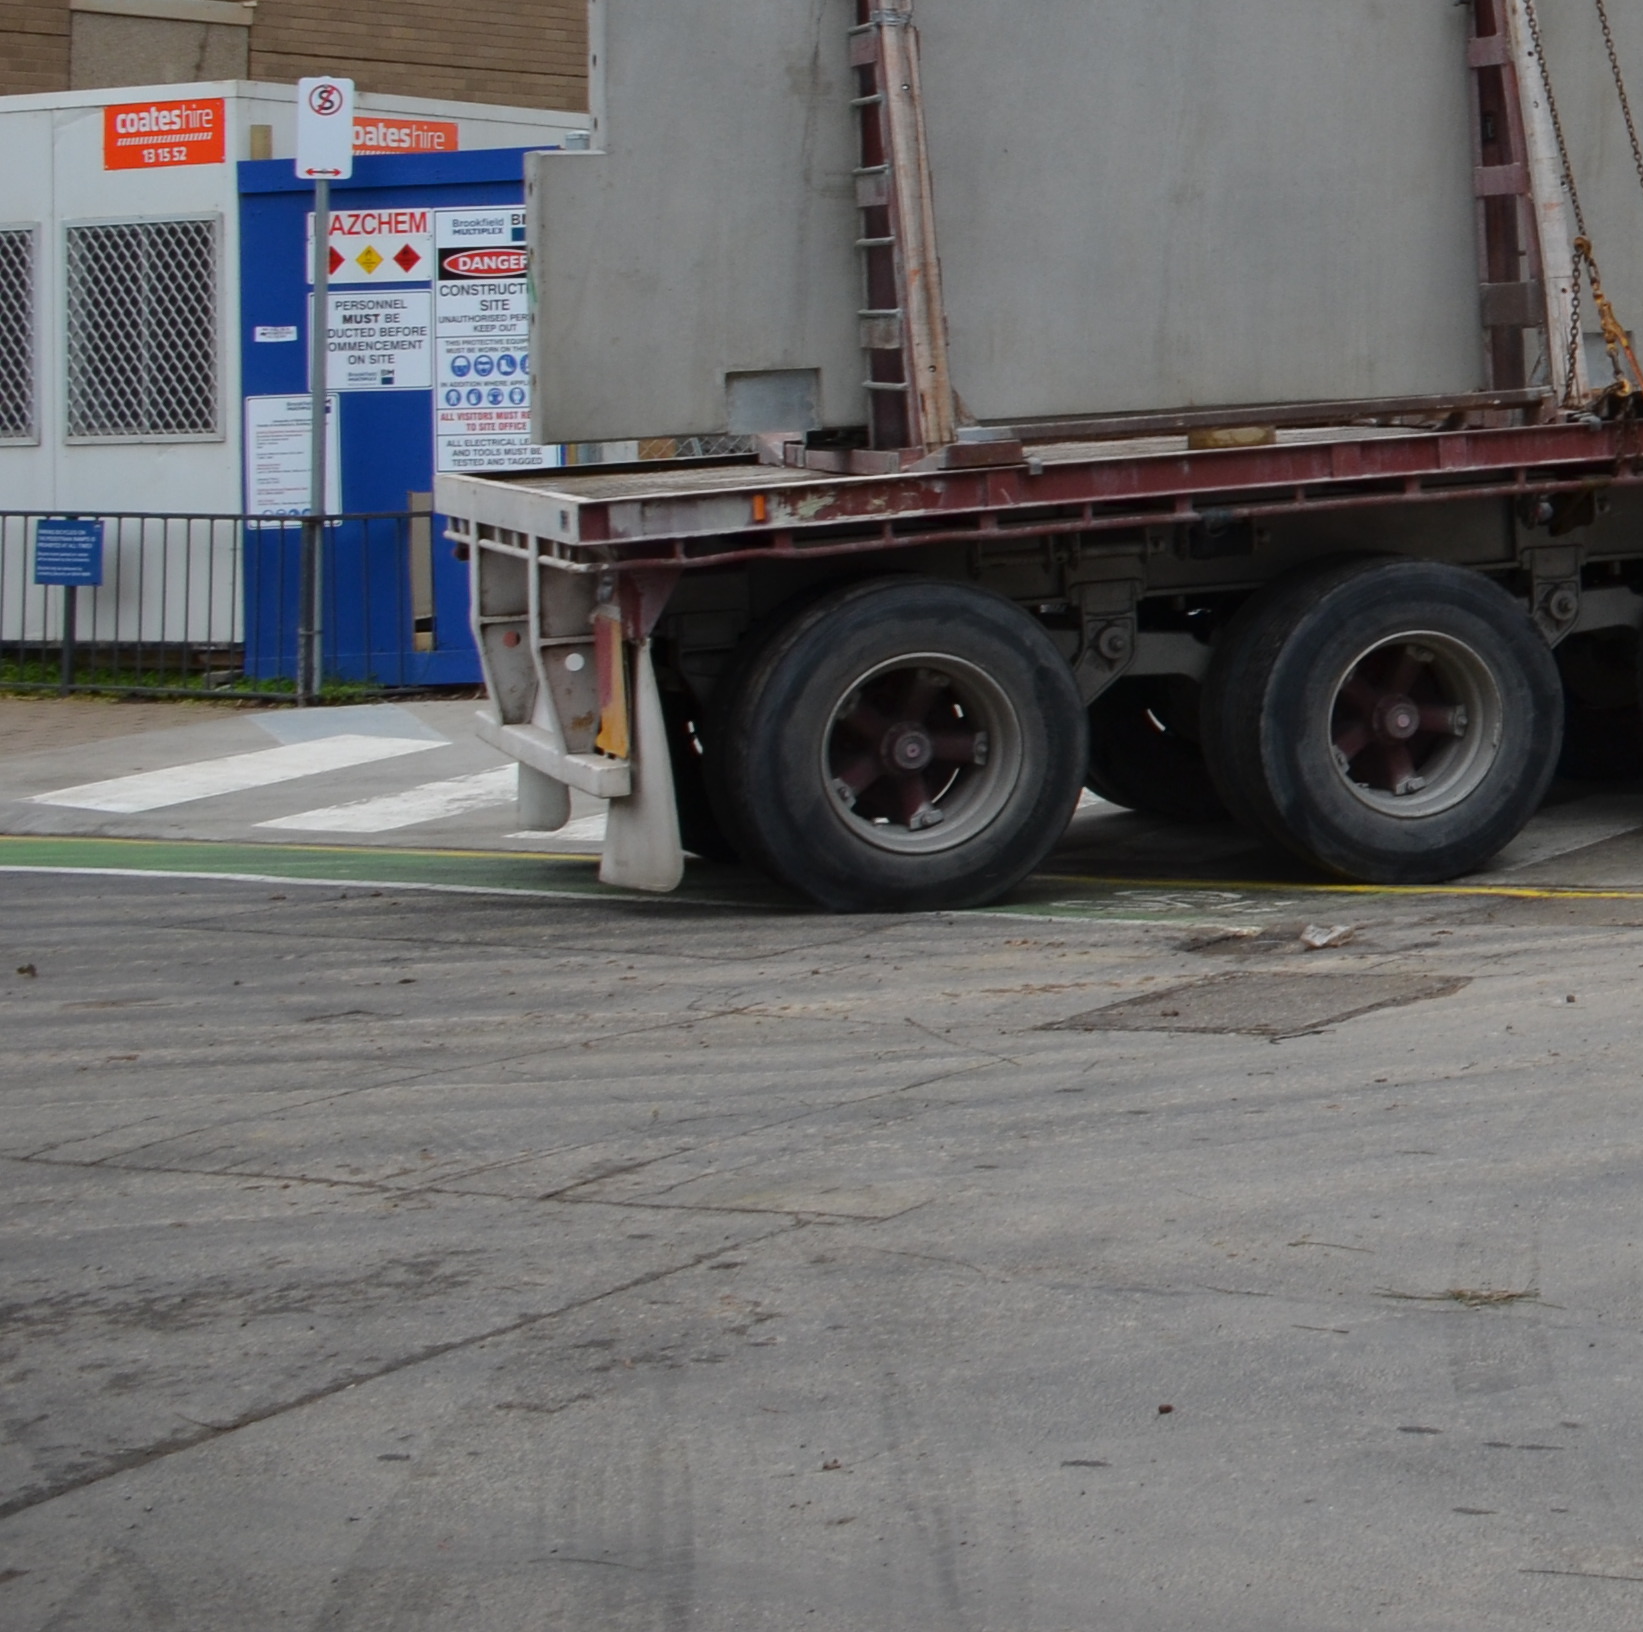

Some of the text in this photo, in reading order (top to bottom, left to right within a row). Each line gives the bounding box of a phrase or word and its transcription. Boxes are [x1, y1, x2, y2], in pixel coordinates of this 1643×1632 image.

[116, 104, 213, 134] coateshire
[352, 125, 445, 150] oateshire
[143, 147, 187, 162] 13 15 52
[329, 211, 427, 235] AZCHEM
[452, 218, 504, 228] Brookfield
[335, 299, 408, 310] PERSONNEL
[480, 299, 510, 311] SITE
[342, 313, 400, 324] MUST BE
[327, 326, 428, 338] DUCTED BEFORE
[473, 323, 517, 332] KEEP OUT
[328, 340, 423, 352] OMMENCEMENT
[348, 353, 395, 365] ON SITE
[440, 413, 455, 421] ALL
[457, 412, 493, 420] VISITORS
[496, 411, 518, 420] MUST
[466, 422, 527, 431] TO SITE OFFICE
[446, 439, 462, 447] ALL
[465, 438, 516, 446] ELECTRICAL
[473, 448, 502, 456] TOOLS
[504, 447, 528, 455] MUST
[531, 446, 542, 454] BE
[452, 458, 485, 466] TESTED
